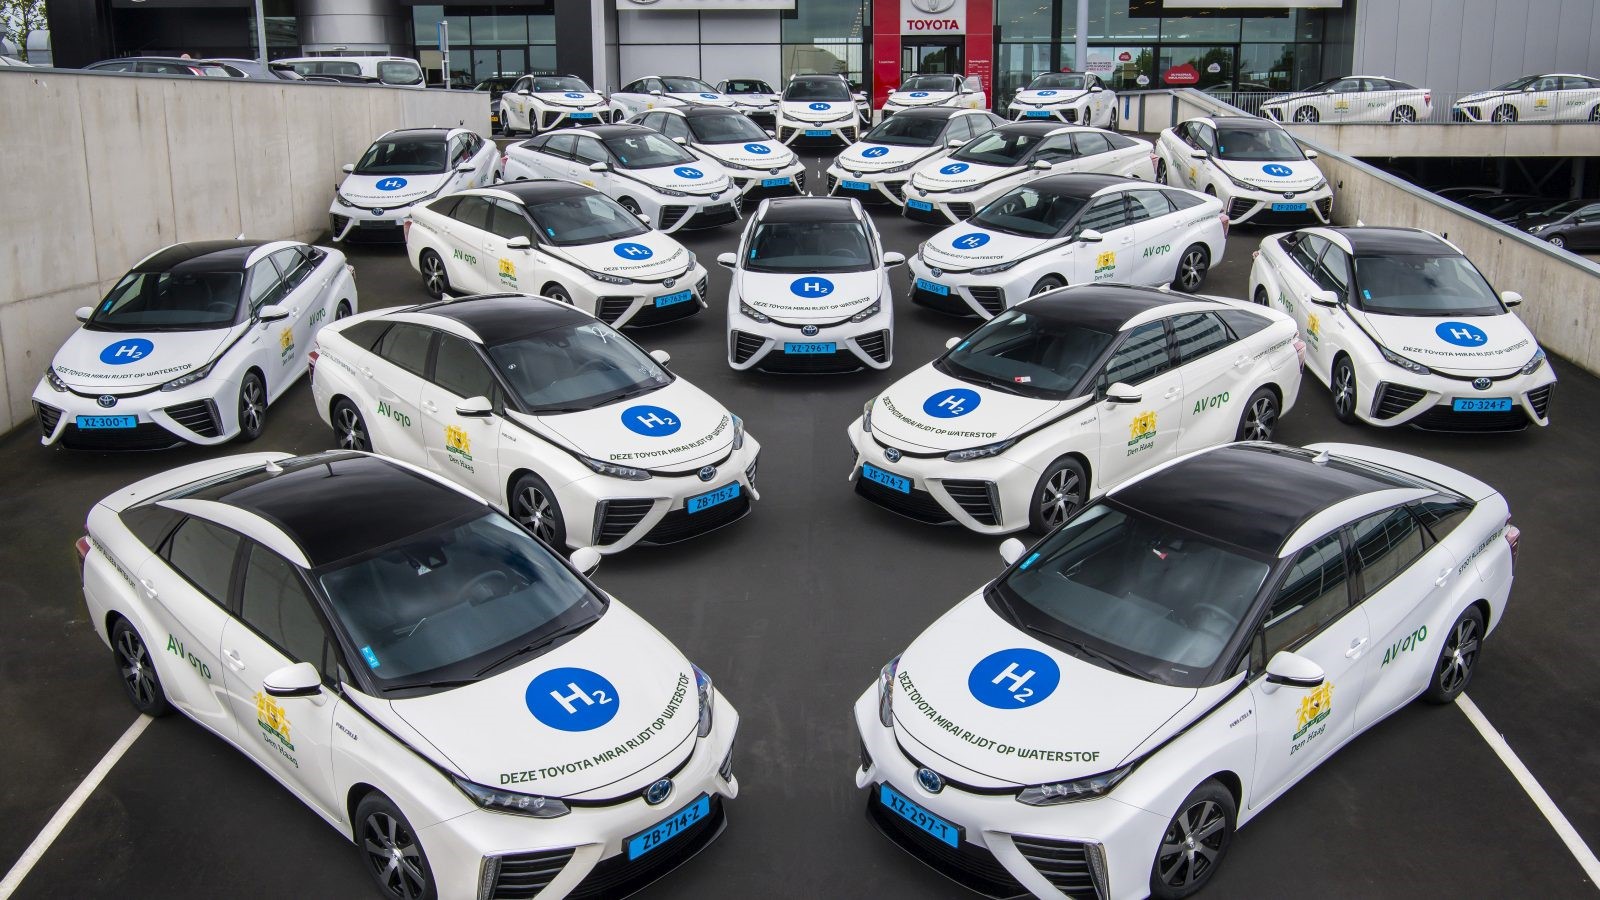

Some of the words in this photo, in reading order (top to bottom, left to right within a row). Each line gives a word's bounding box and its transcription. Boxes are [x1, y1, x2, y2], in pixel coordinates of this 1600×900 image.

[907, 20, 959, 30] TOYOTA
[624, 247, 650, 256] H2
[962, 236, 980, 248] H2
[1143, 248, 1154, 258] AV
[1156, 244, 1170, 256] 070
[454, 248, 463, 260] AV
[465, 255, 476, 265] 070
[804, 282, 828, 293] H2
[1450, 329, 1483, 341] H2
[115, 346, 142, 358] H2
[146, 364, 192, 376] WATERSTOF
[938, 395, 966, 415] H2
[1193, 397, 1208, 415] AV
[1210, 391, 1230, 409] 070
[84, 418, 128, 426] XZ-300-T
[377, 401, 391, 417] AV
[394, 411, 410, 428] 070
[636, 412, 676, 428] H2
[901, 416, 916, 427] MIRAI
[916, 423, 936, 432] RIJDT
[634, 450, 667, 459] TOYOTA
[668, 444, 690, 454] MIRAI
[1127, 447, 1139, 457] Den
[1140, 441, 1154, 452] Haag
[449, 454, 459, 465] Den
[460, 460, 474, 474] Haag
[869, 468, 904, 490] ZF-274-Z
[697, 488, 734, 509] ZB-715-Z
[1458, 556, 1472, 575] STOOT
[167, 634, 184, 659] AV
[189, 653, 211, 679] 070
[1380, 639, 1402, 670] AV
[1402, 625, 1427, 652] 070
[991, 662, 1037, 703] H2
[550, 682, 613, 714] H2
[898, 671, 914, 695] DEZE
[907, 689, 937, 719] TOYOTA
[934, 715, 964, 737] MIRAI
[961, 731, 997, 750] RIJDT
[997, 743, 1015, 755] OP
[1018, 747, 1100, 762] WATERSTOF
[500, 770, 537, 785] DEZE
[539, 759, 593, 779] TOYOTA
[593, 744, 628, 765] MIRAI
[626, 728, 656, 750] RIJDT
[652, 718, 665, 730] OP
[661, 672, 689, 719] WATERSTOF
[263, 732, 278, 749] Den
[278, 744, 298, 768] Haag
[1290, 739, 1306, 756] Den
[1306, 724, 1326, 744] Haag
[890, 794, 948, 839] XZ-297-T
[643, 805, 700, 850] ZB-714-Z
